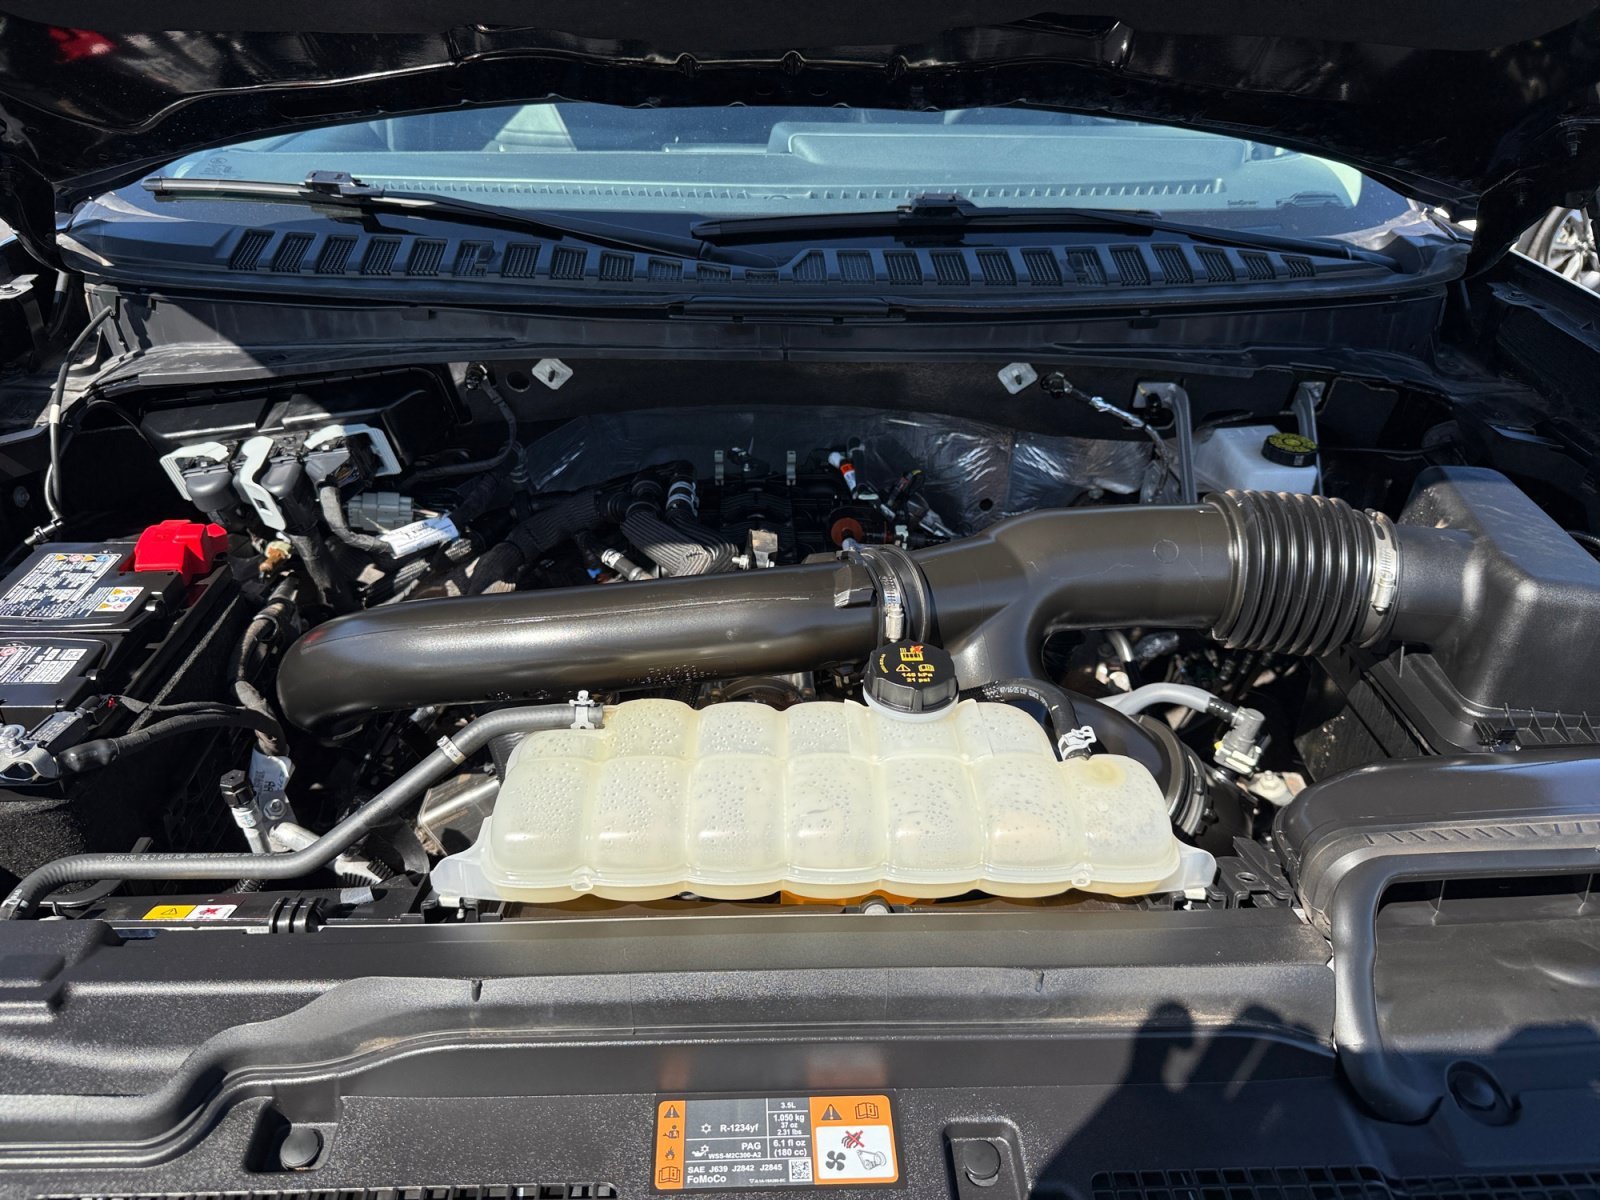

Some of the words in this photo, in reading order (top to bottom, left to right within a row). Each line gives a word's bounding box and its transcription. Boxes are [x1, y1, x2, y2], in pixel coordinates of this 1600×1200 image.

[780, 1101, 797, 1109] 3.5L
[773, 1113, 794, 1122] 1.050
[795, 1113, 805, 1123] kg
[719, 1123, 759, 1133] R-1234yf
[791, 1128, 802, 1136] lbs
[741, 1142, 761, 1151] PAG
[773, 1139, 785, 1147] 6.1
[787, 1139, 794, 1147] fl
[773, 1148, 792, 1158] (180
[793, 1148, 808, 1157] cc)
[687, 1165, 706, 1174] SAE
[708, 1165, 729, 1173] J639
[731, 1164, 755, 1173] J2842
[759, 1163, 783, 1172] J2845
[686, 1174, 727, 1184] FoMoCo
